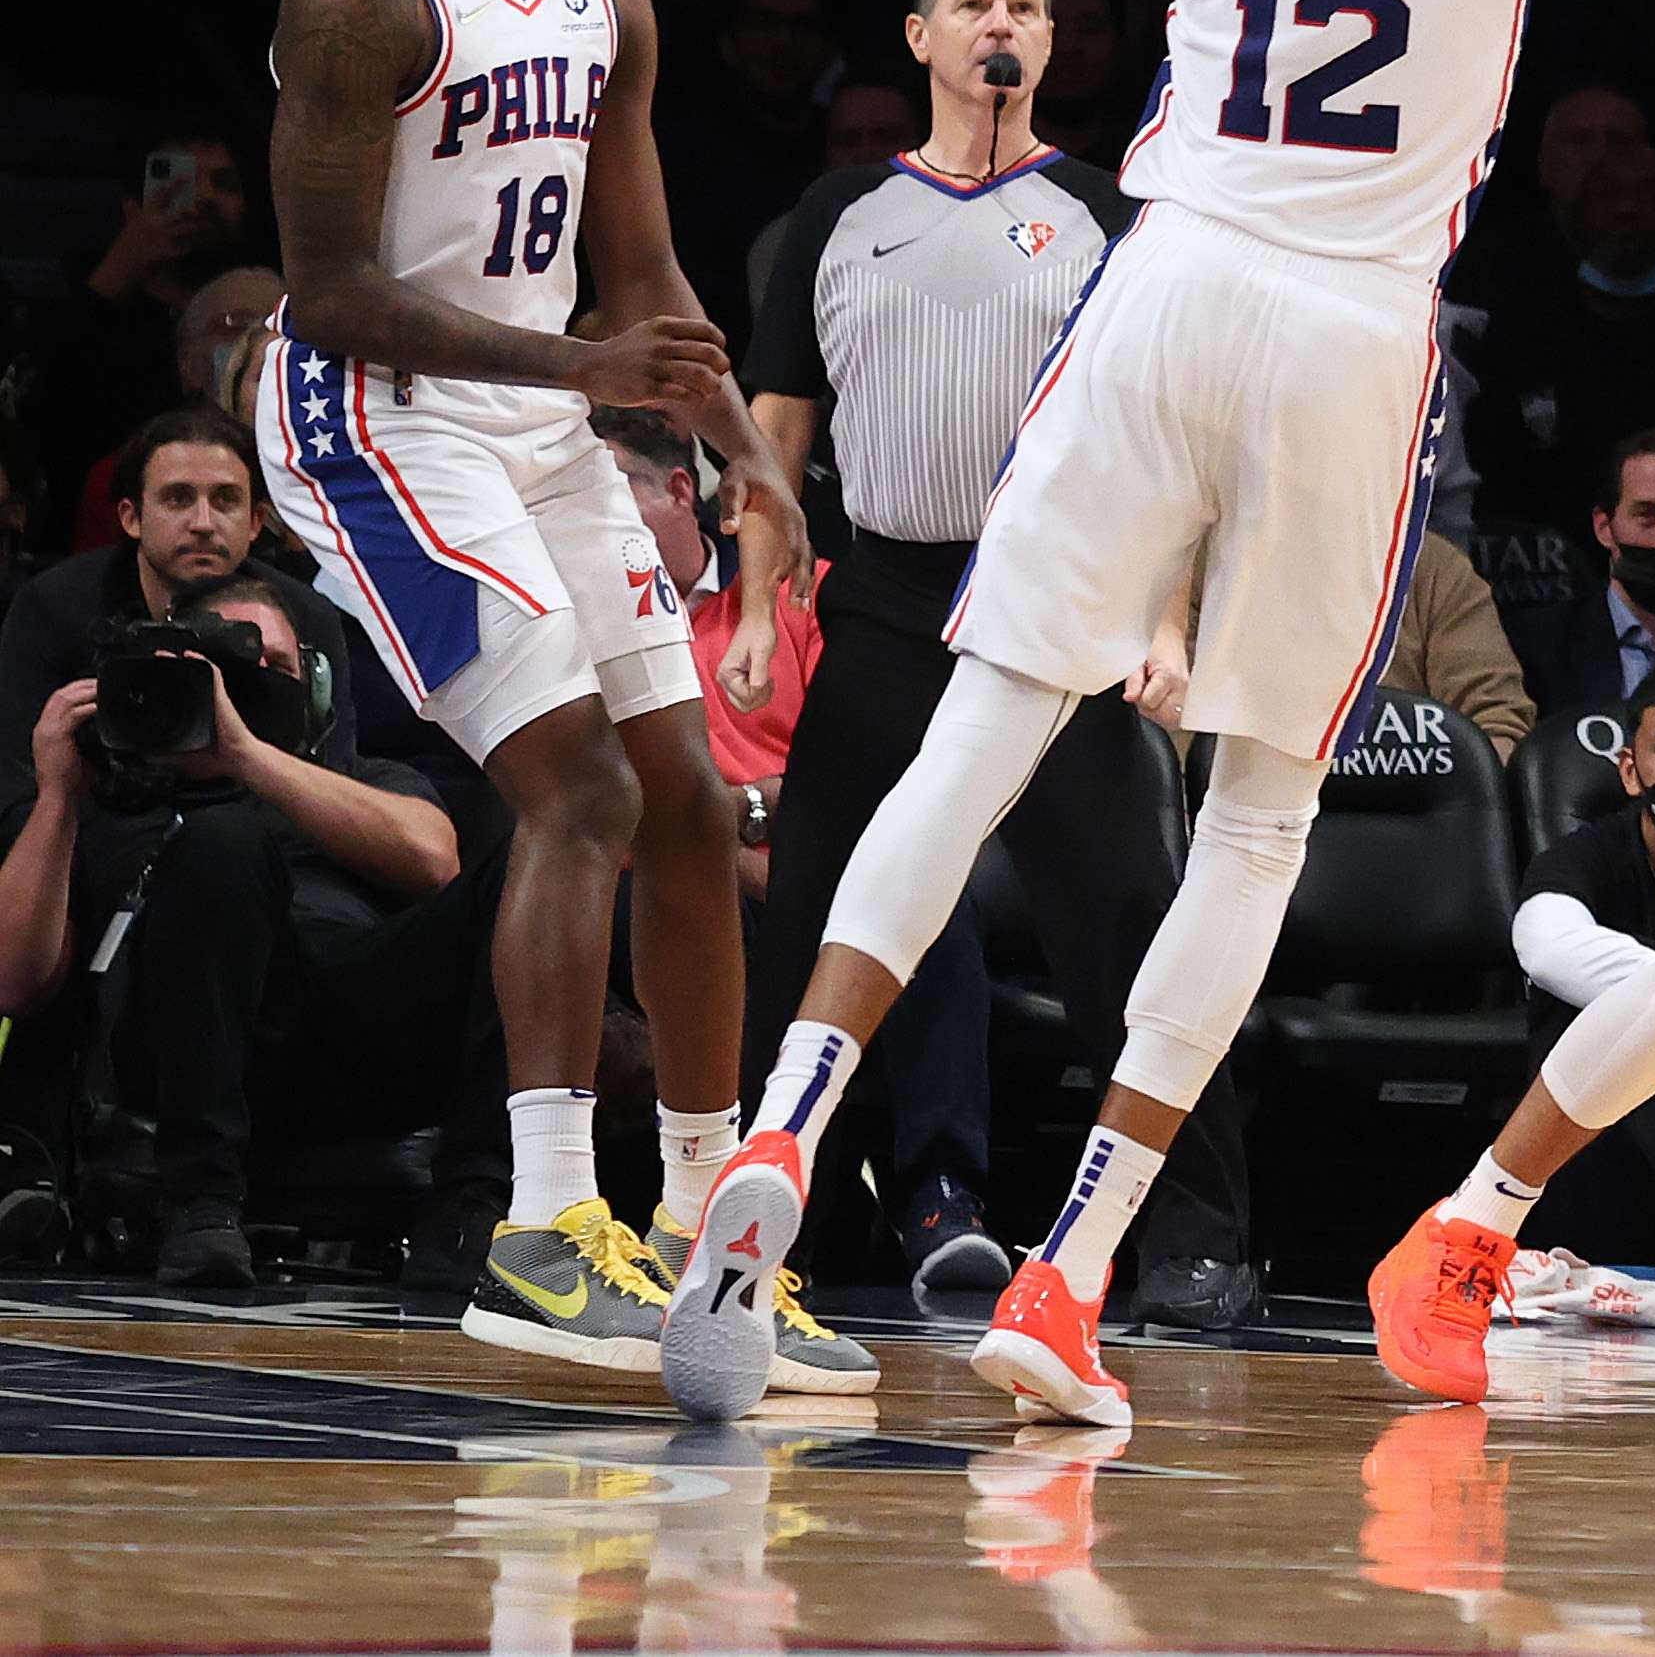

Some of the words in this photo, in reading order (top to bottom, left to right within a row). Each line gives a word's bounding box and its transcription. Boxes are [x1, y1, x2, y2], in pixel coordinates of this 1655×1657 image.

[483, 174, 568, 278] 18
[626, 564, 678, 619] 76
[1331, 746, 1454, 776] IRWAYS
